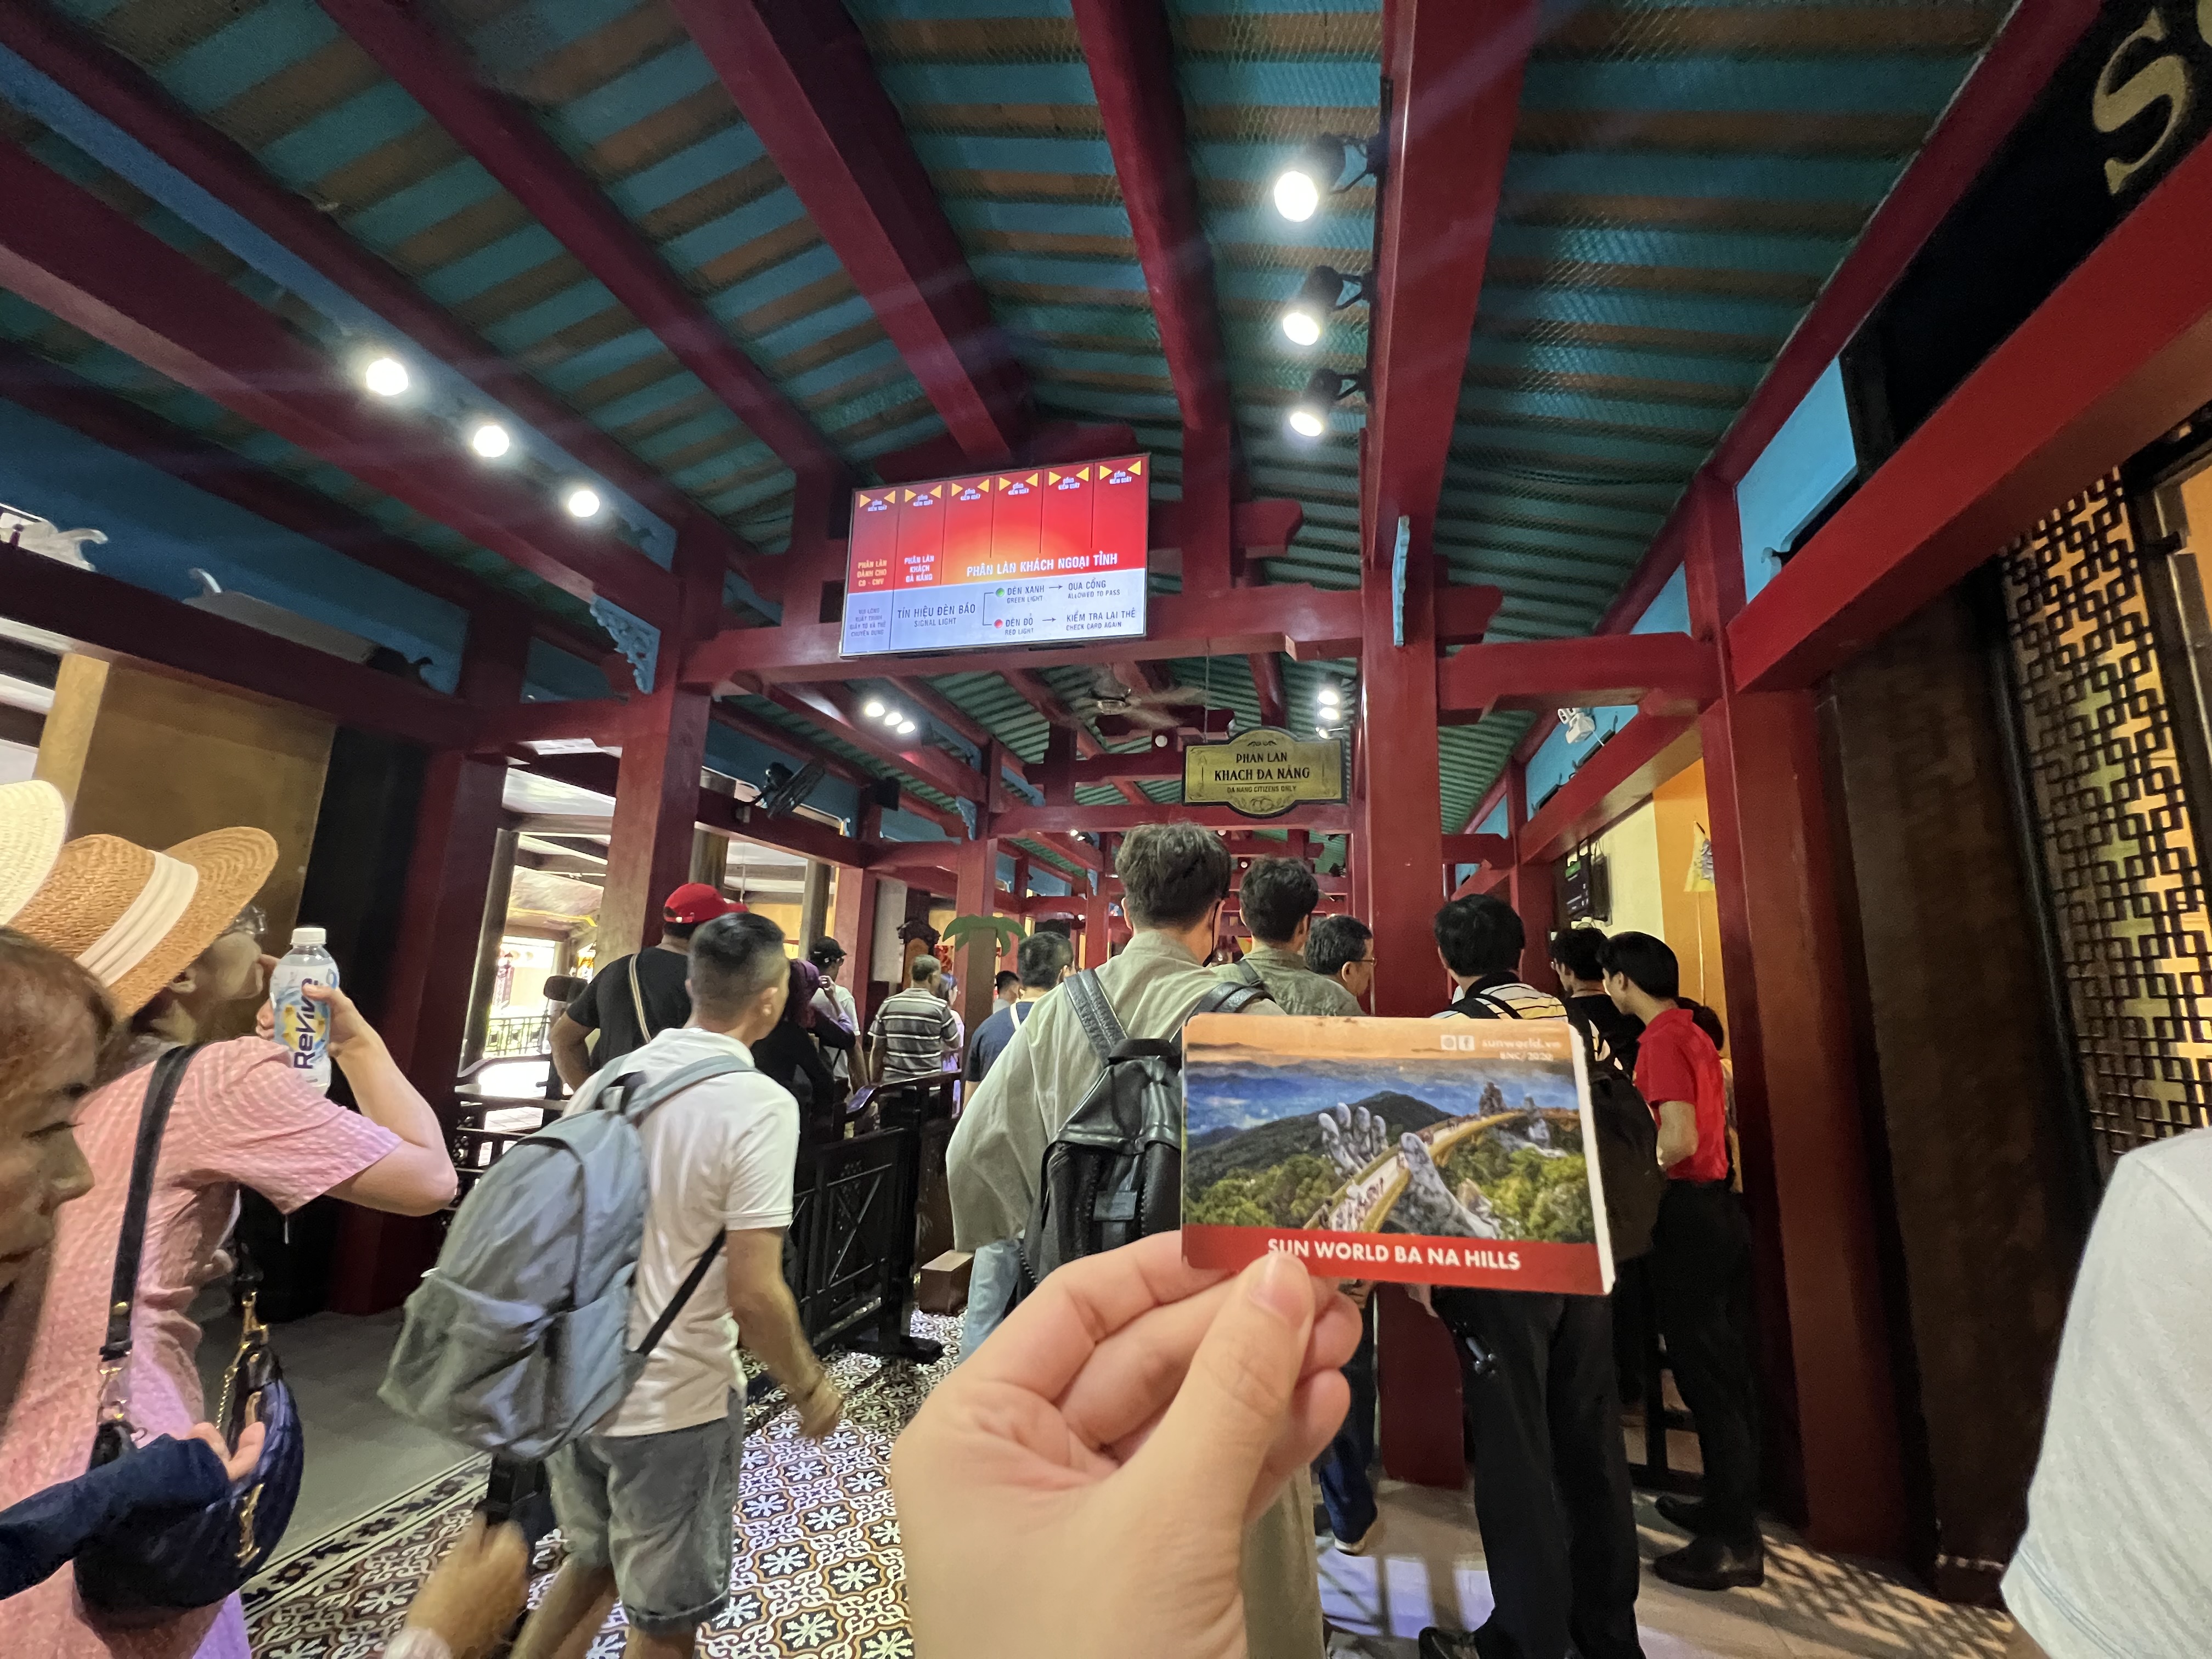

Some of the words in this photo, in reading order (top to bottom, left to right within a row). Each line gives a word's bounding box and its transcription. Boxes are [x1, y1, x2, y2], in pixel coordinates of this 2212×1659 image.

[2092, 0, 2212, 195] S
[967, 563, 993, 577] PHÂN
[997, 561, 1016, 574] LÀN
[1020, 557, 1054, 572] KHÁCH
[1058, 556, 1090, 569] NGOẠI
[1093, 550, 1118, 567] TỈNH
[1025, 585, 1045, 594] XANH
[1068, 591, 1094, 599] ALLOWED
[898, 606, 910, 619] TÍN
[958, 602, 975, 614] BÁO
[1089, 612, 1103, 621] TRA
[914, 619, 936, 628] SIGNAL
[939, 617, 957, 625] LIGHT
[1267, 1238, 1310, 1257] SUN
[1314, 1240, 1389, 1262] WORLD
[1394, 1245, 1424, 1265] BA
[1427, 1247, 1460, 1266] NA
[1464, 1249, 1521, 1270] HILLS
